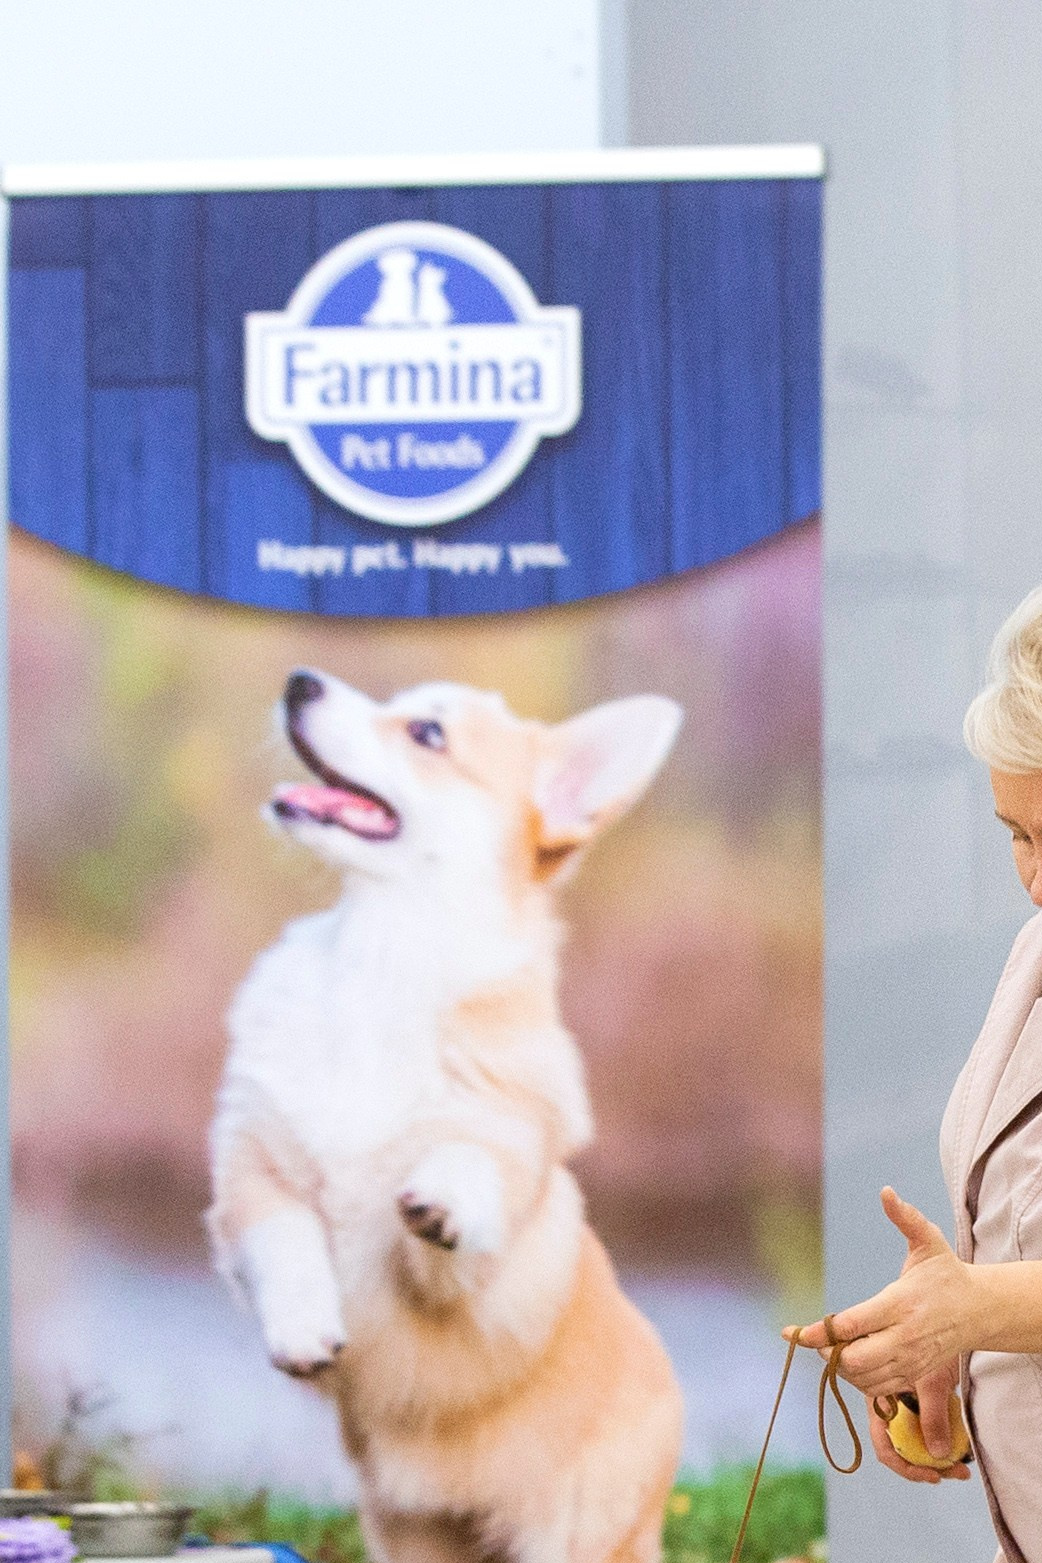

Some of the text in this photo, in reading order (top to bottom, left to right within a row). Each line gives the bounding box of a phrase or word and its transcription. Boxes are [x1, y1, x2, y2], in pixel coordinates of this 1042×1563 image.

[282, 340, 543, 407] Farmina
[340, 432, 486, 470] Pet Foods
[256, 538, 345, 577] Happy
[412, 536, 500, 576] Happy
